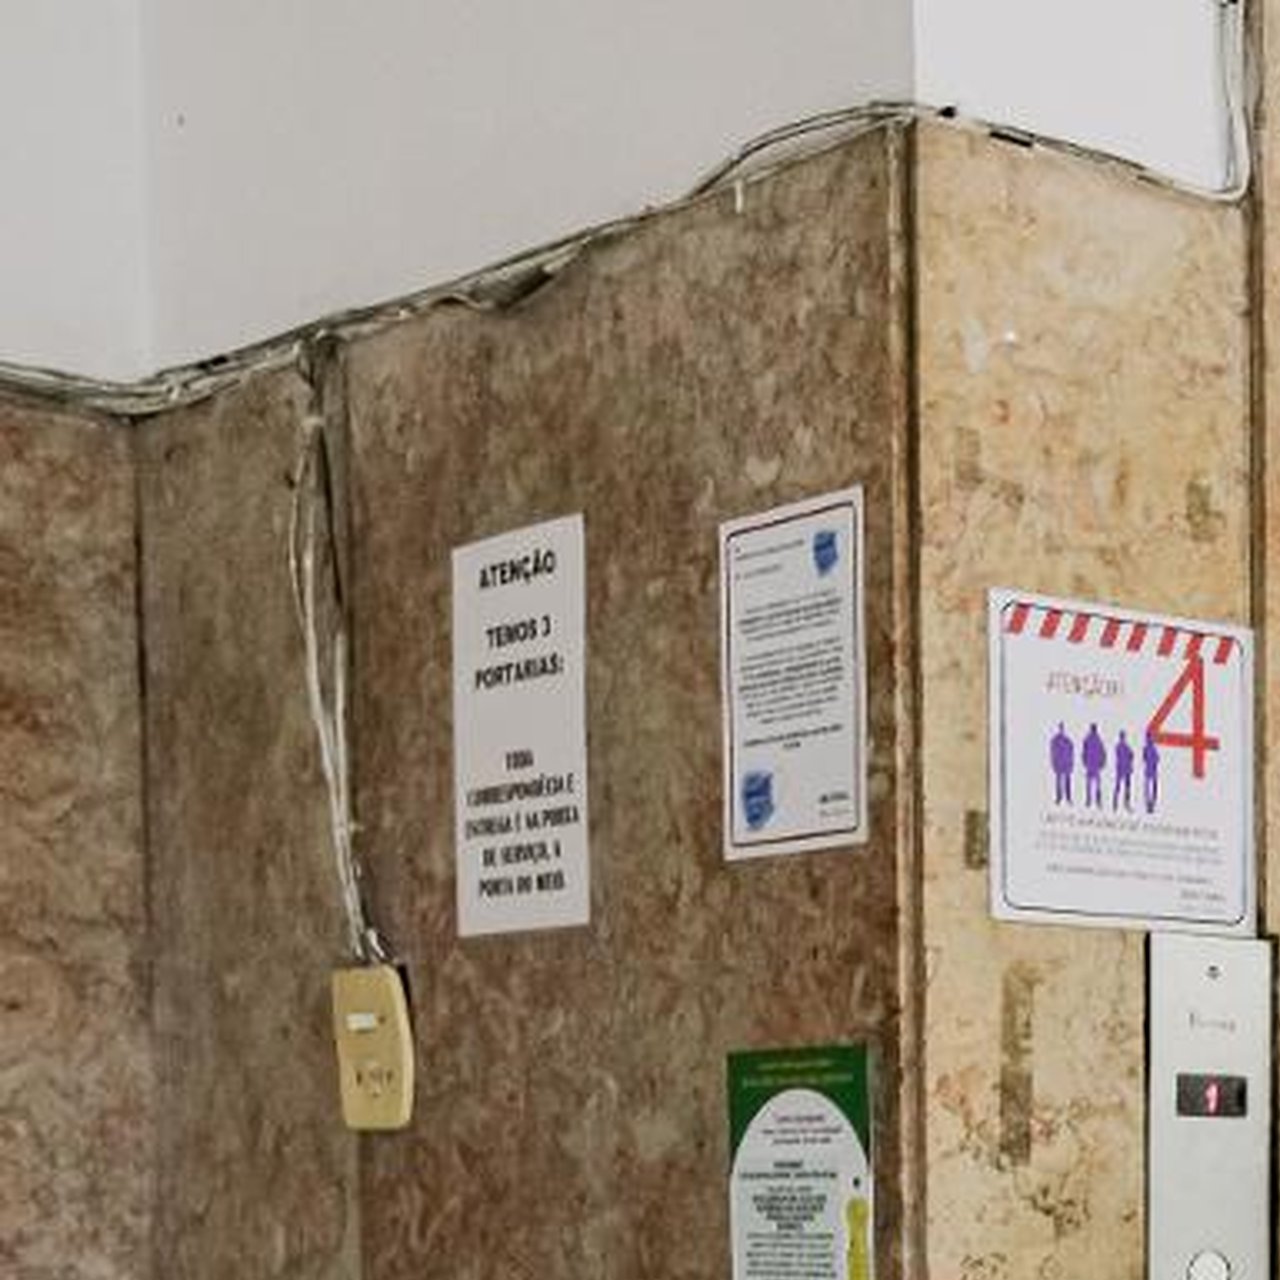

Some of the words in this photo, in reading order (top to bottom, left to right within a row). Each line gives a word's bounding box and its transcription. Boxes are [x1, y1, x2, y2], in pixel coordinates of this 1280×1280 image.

[479, 549, 556, 588] ATENÇÃO
[486, 618, 537, 648] TEMOS
[1149, 646, 1220, 779] 4
[1205, 1083, 1218, 1113] 1
